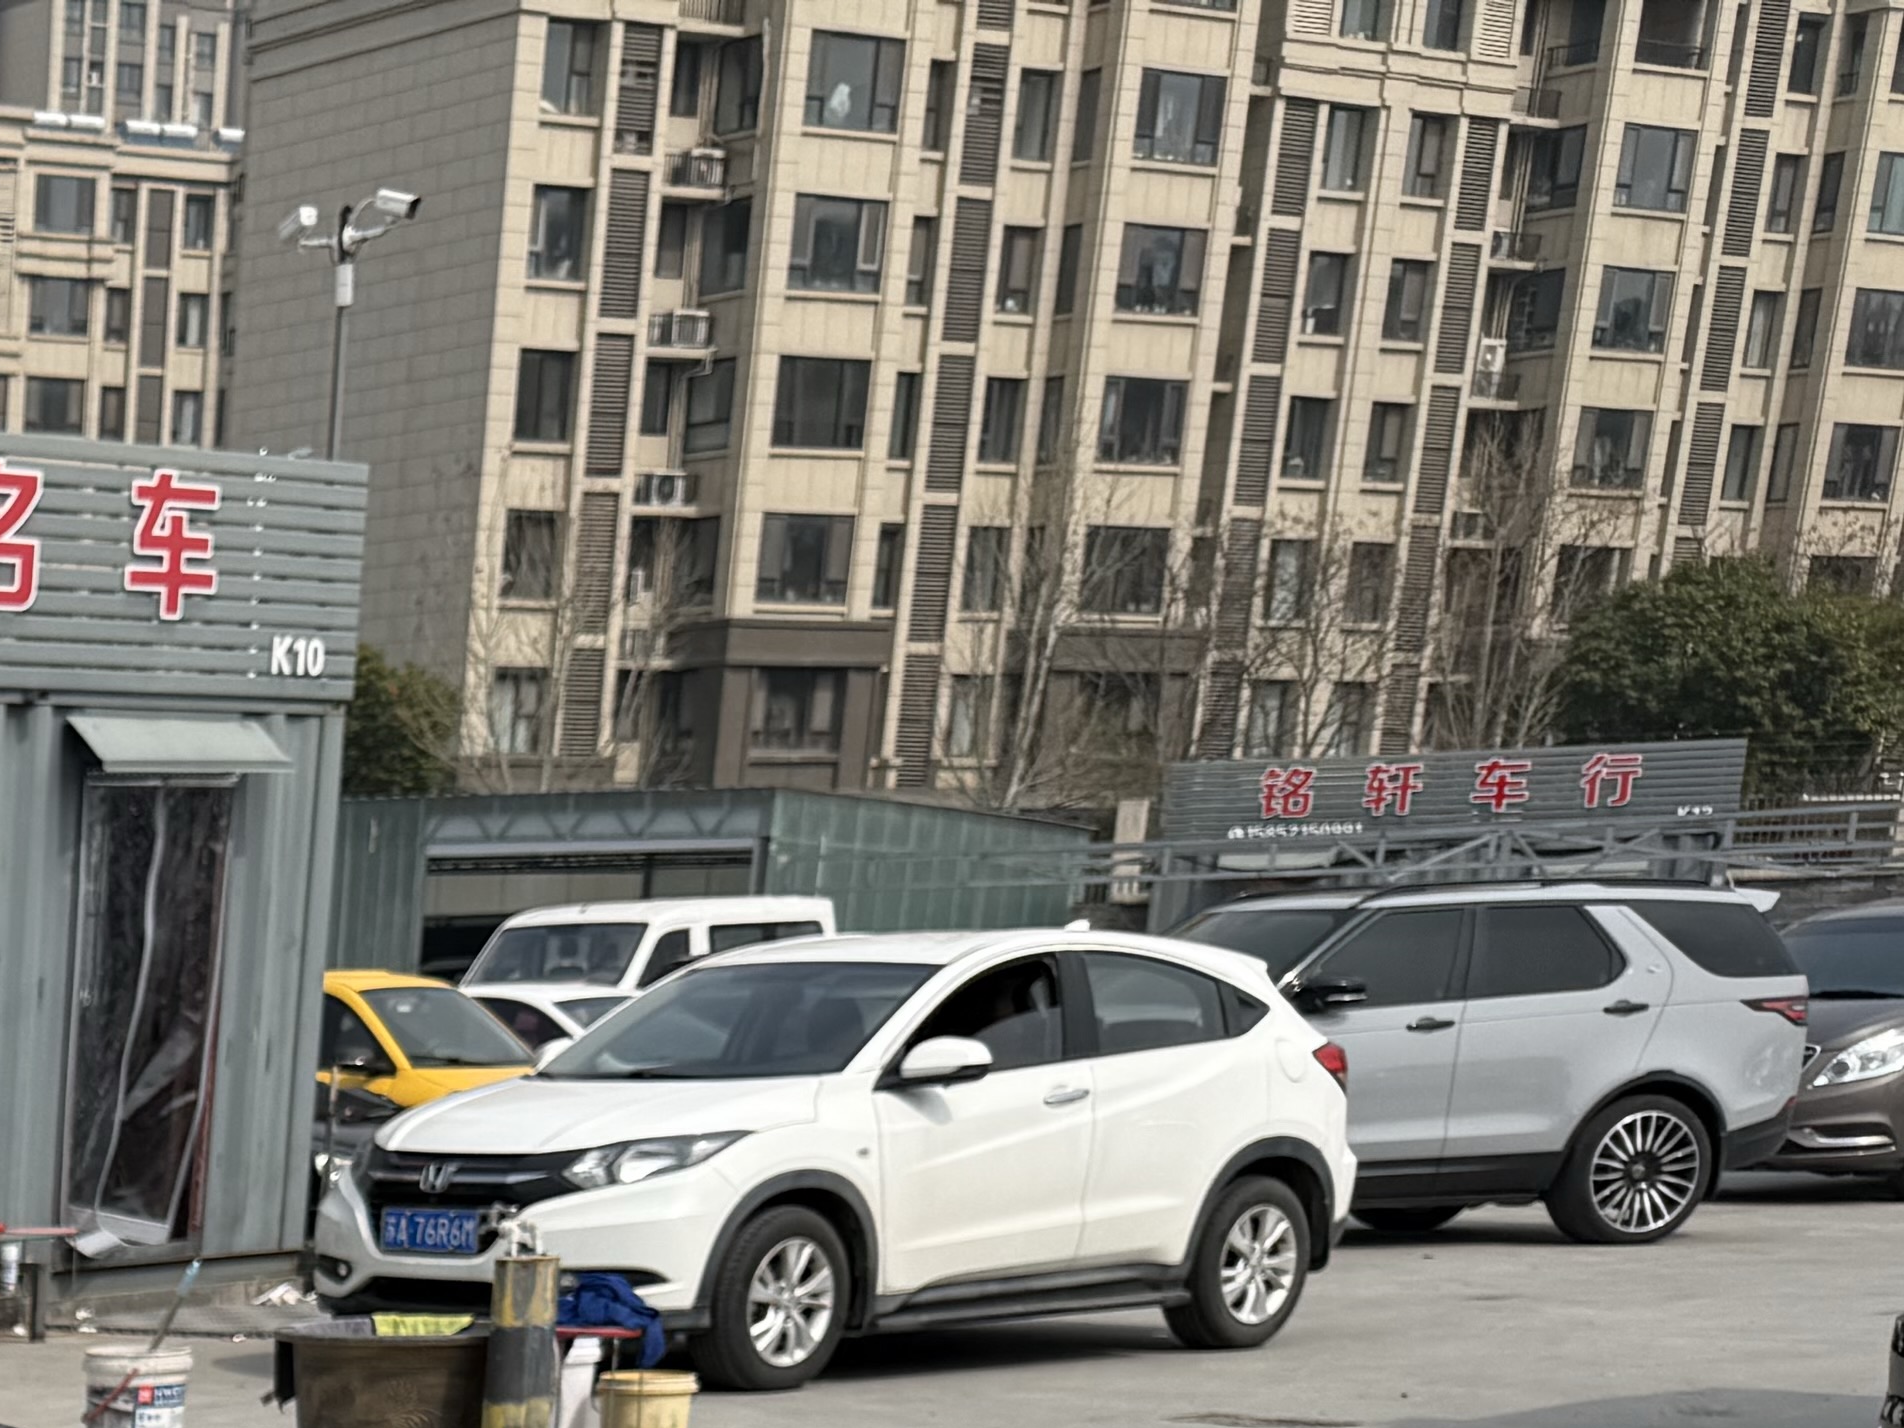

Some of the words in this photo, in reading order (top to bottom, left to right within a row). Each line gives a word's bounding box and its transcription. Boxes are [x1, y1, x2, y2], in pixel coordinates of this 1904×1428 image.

[271, 637, 325, 678] K10
[1259, 753, 1643, 819] 铭轩车行
